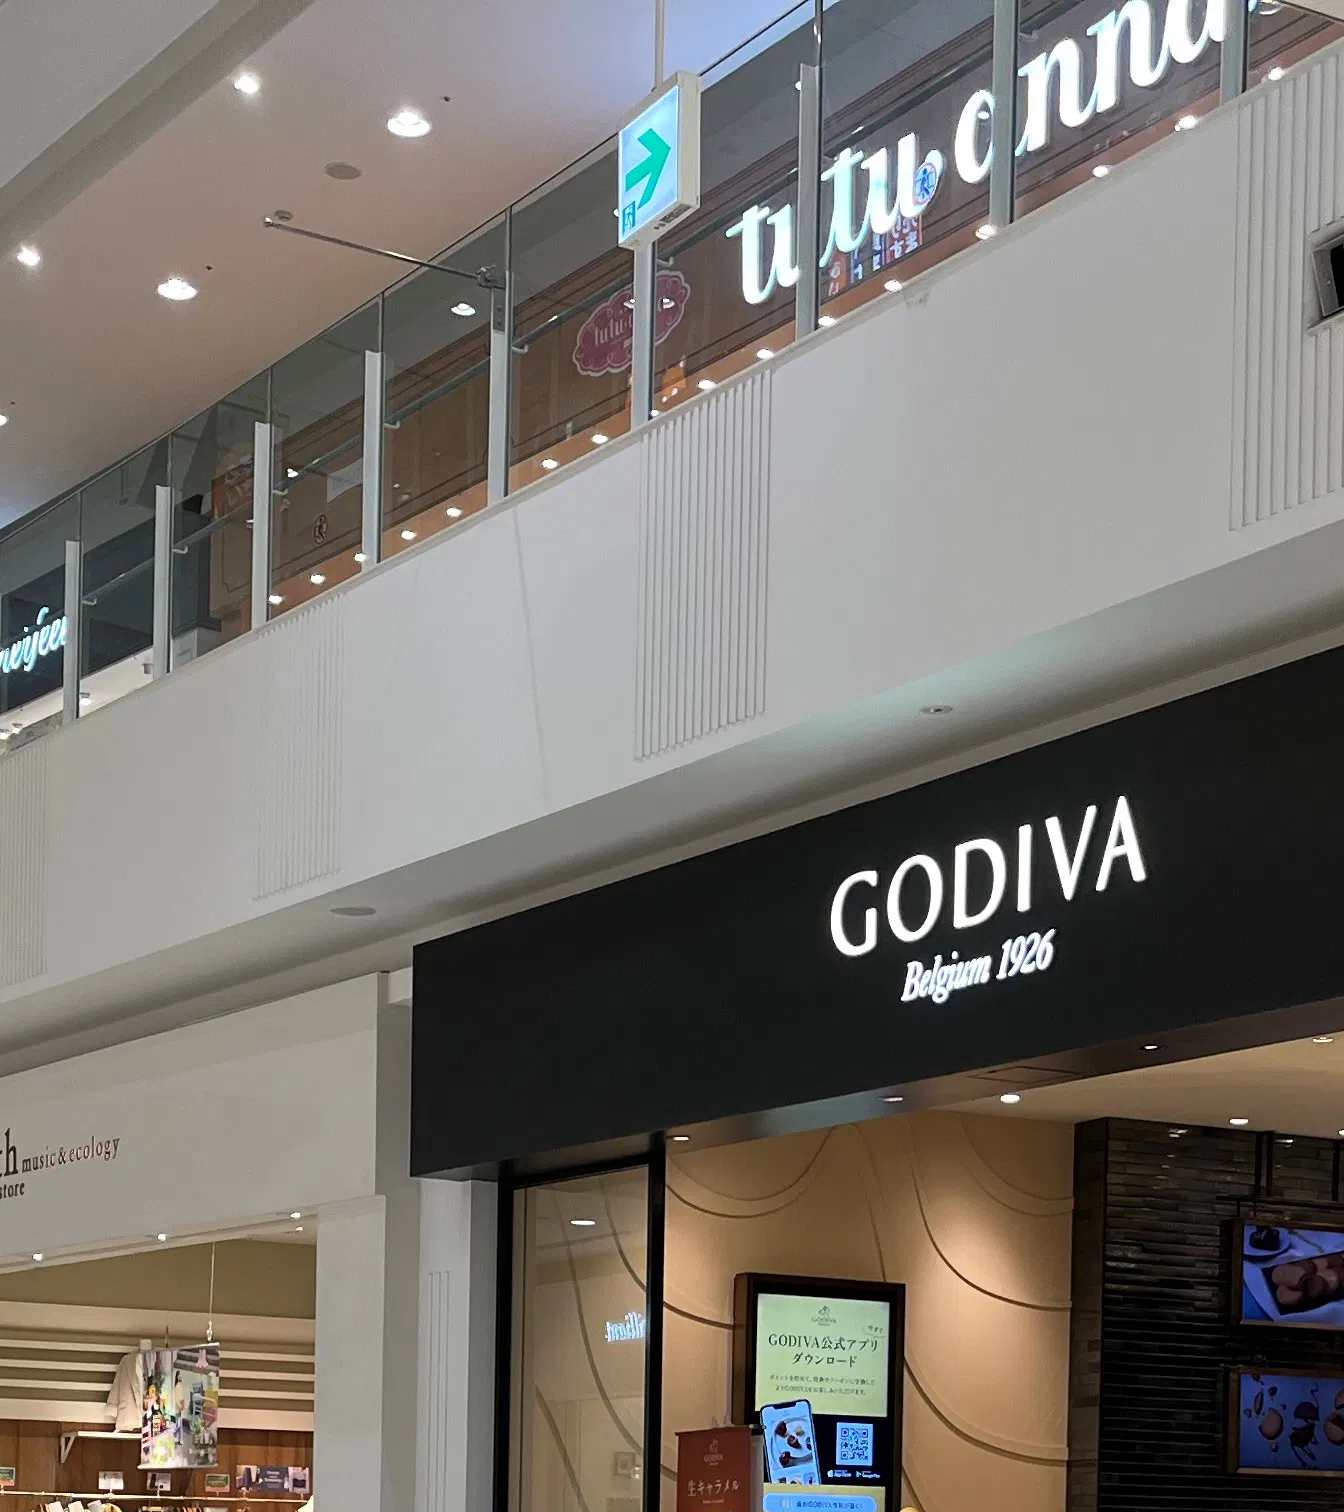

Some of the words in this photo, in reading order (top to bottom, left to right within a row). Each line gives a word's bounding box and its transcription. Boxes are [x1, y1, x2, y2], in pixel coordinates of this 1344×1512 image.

[830, 795, 1147, 957] GODIVA
[901, 951, 992, 1004] Belgium
[996, 928, 1056, 980] 1926
[768, 1333, 879, 1352] GODIVA公式アプリ
[792, 1352, 858, 1368] ダウンロード
[687, 1479, 740, 1497] 生キャラメル
